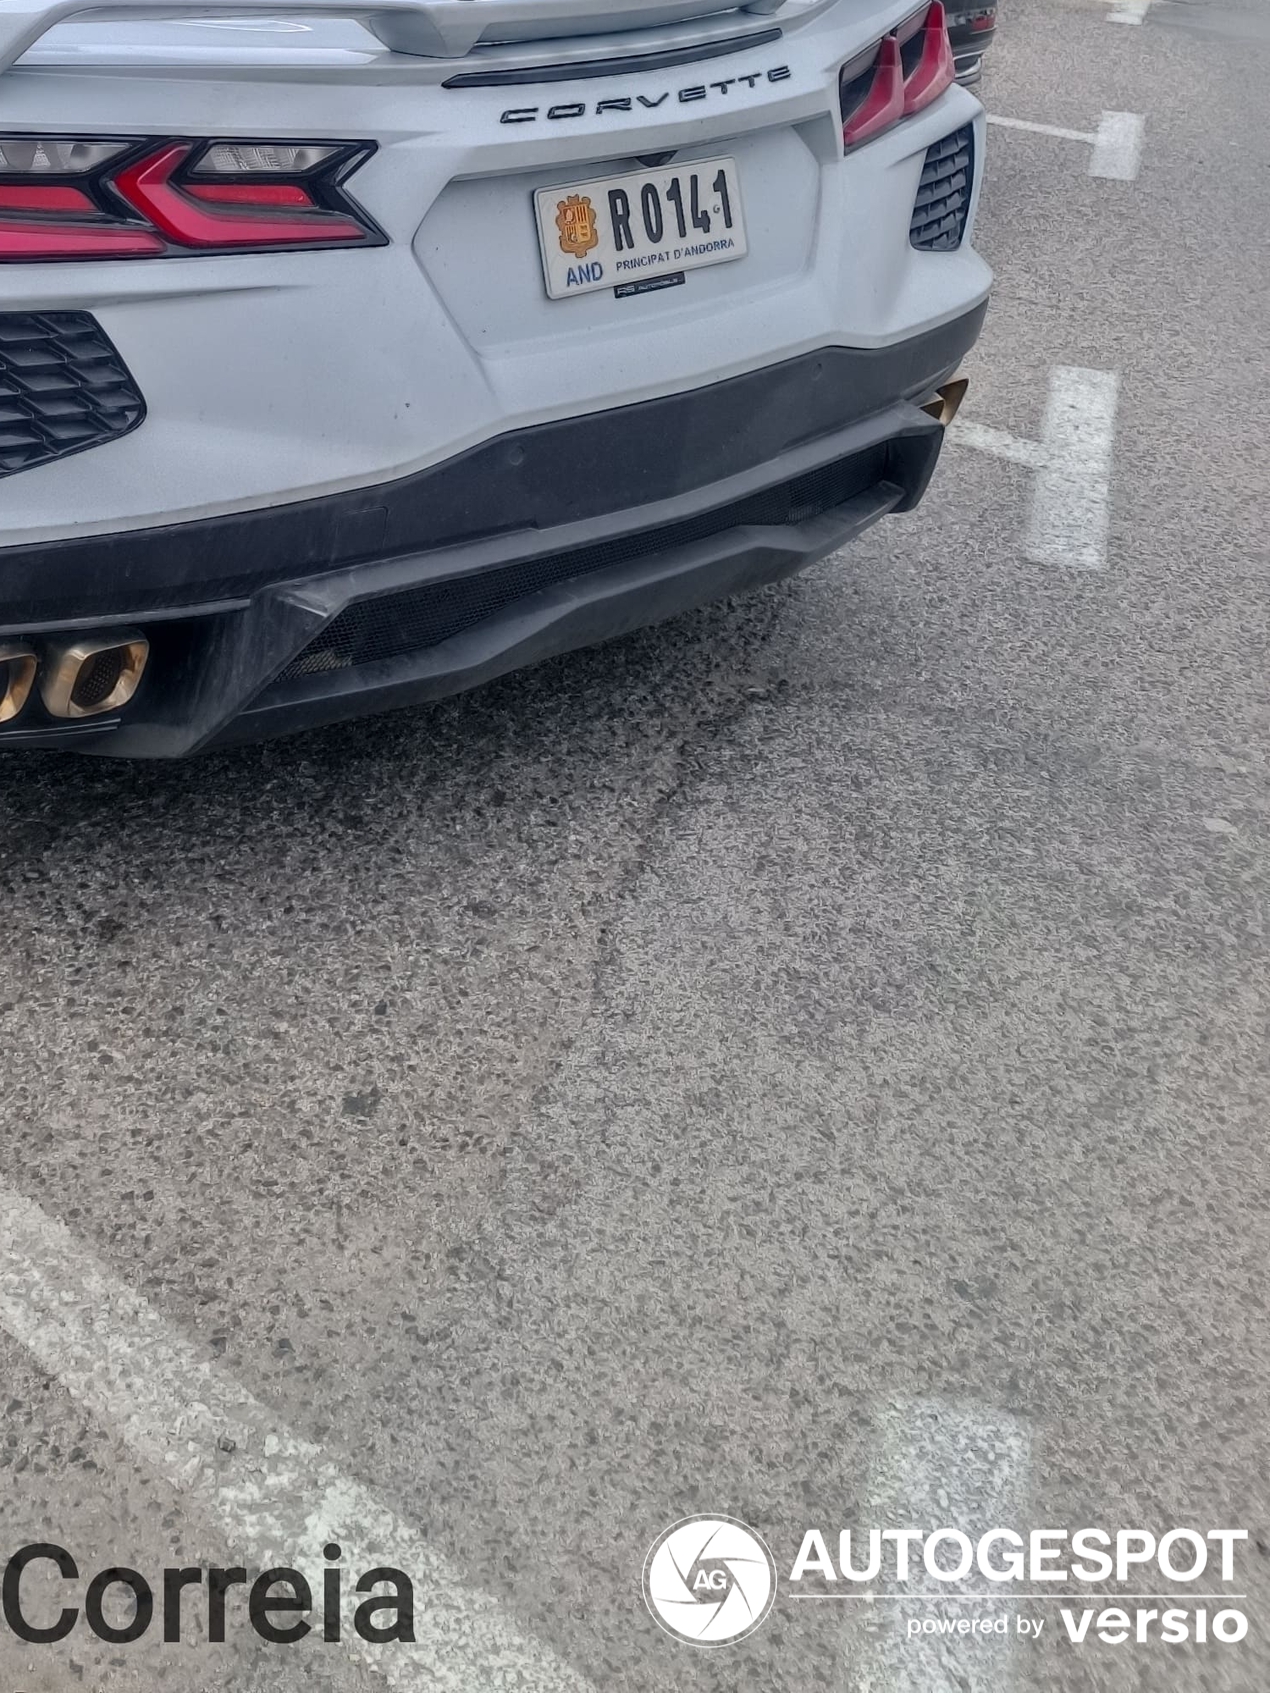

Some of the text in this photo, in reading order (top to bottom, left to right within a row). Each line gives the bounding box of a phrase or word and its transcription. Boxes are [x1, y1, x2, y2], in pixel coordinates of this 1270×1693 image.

[499, 64, 791, 124] CORVETTE
[607, 169, 733, 252] R0141
[565, 261, 604, 288] AND
[615, 237, 735, 272] PRINCIPAT D'ANDORRA
